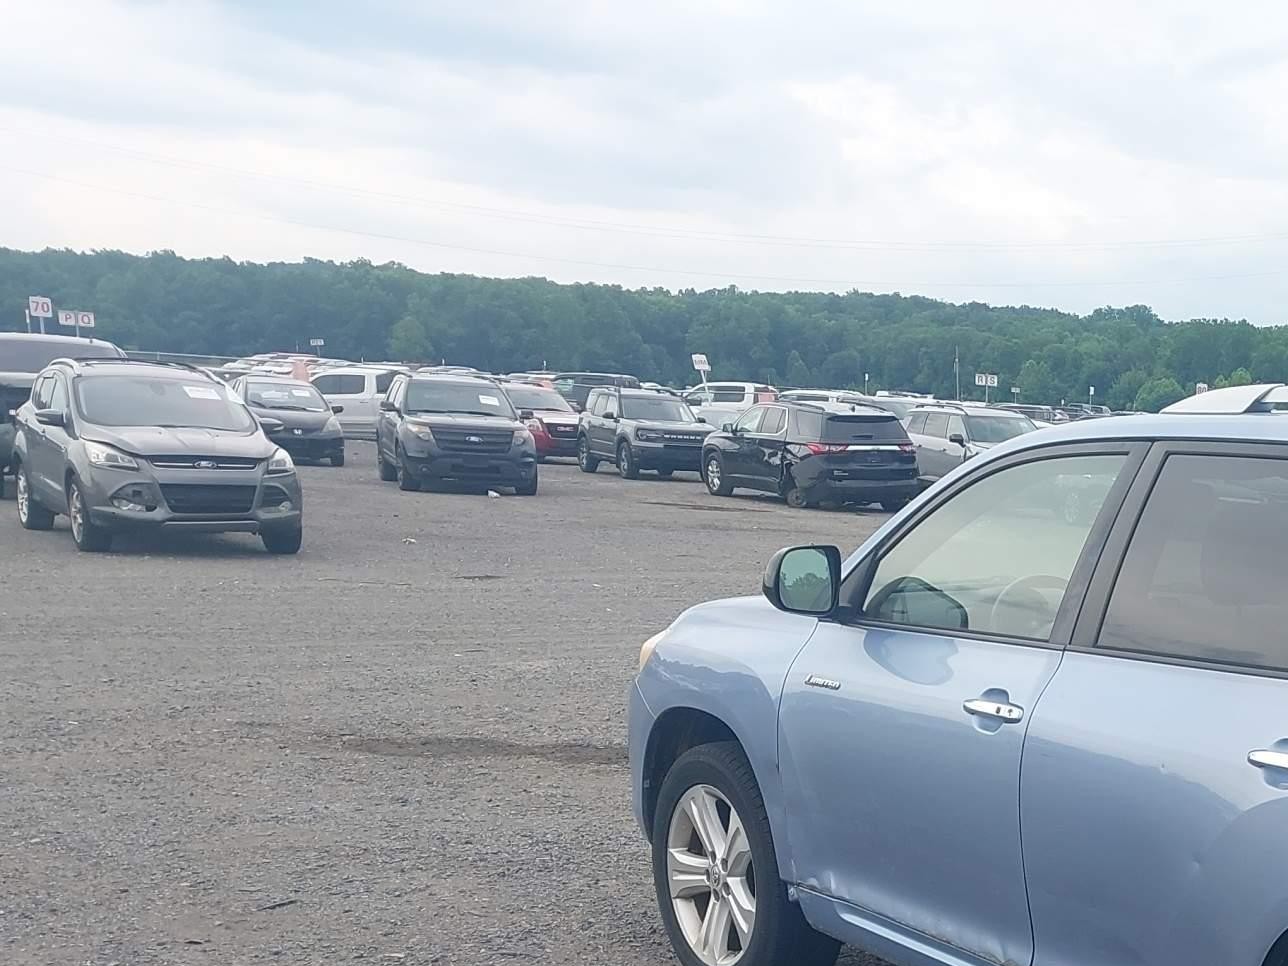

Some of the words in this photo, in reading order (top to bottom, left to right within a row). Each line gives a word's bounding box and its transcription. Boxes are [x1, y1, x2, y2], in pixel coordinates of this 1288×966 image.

[31, 300, 50, 313] 70
[64, 313, 73, 323] P
[80, 313, 91, 325] Q
